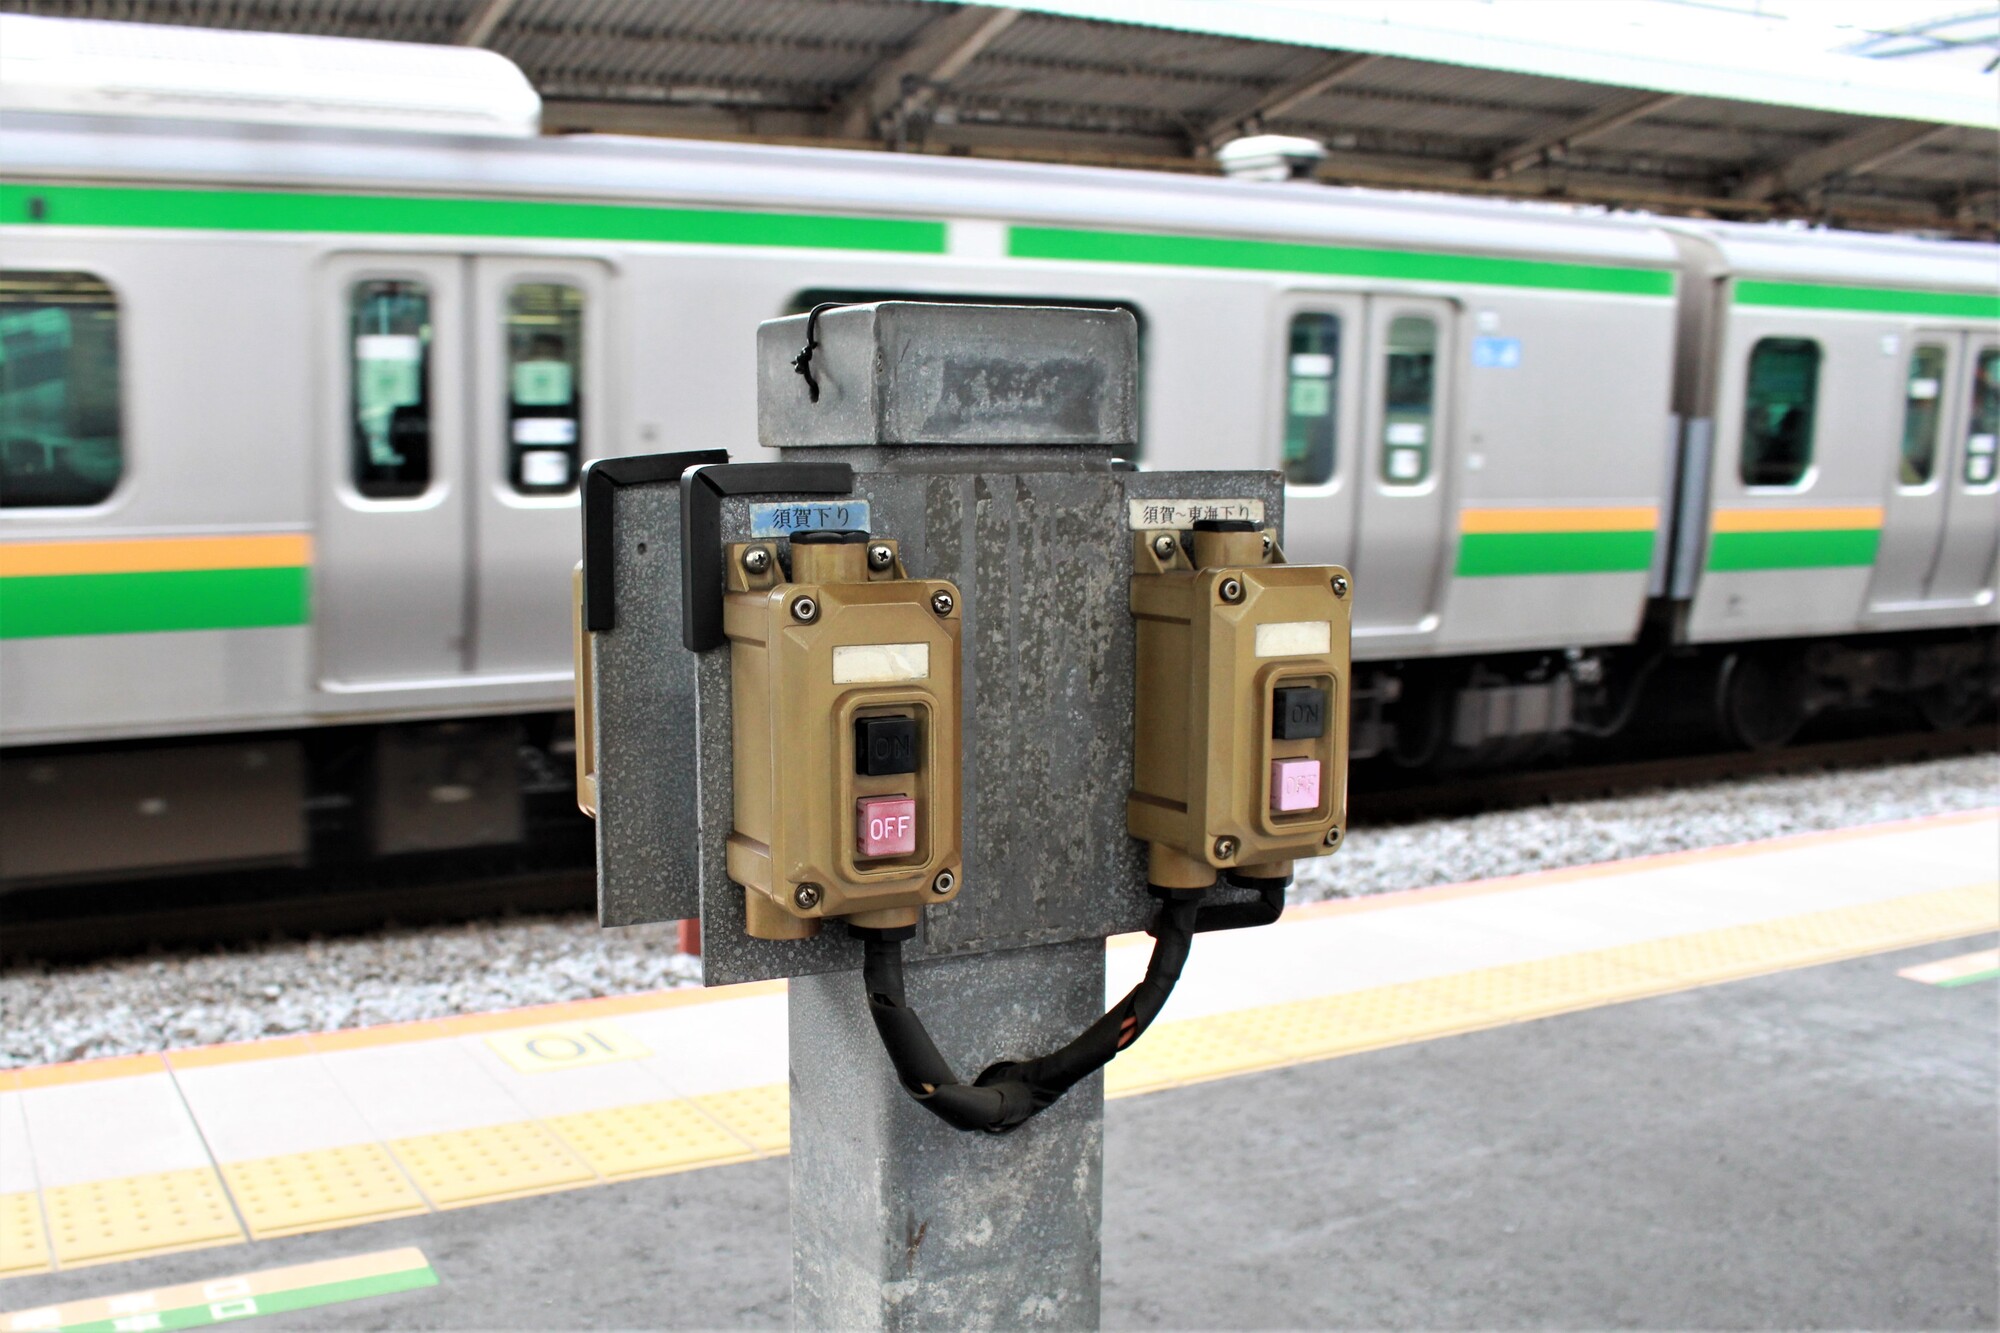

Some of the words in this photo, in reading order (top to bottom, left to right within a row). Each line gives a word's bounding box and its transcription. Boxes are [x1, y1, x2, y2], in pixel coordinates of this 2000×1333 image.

[772, 506, 849, 529] 須賀下り
[1291, 703, 1320, 723] ON
[875, 735, 911, 760] ON
[1285, 773, 1317, 795] OFF
[870, 816, 911, 841] OFF
